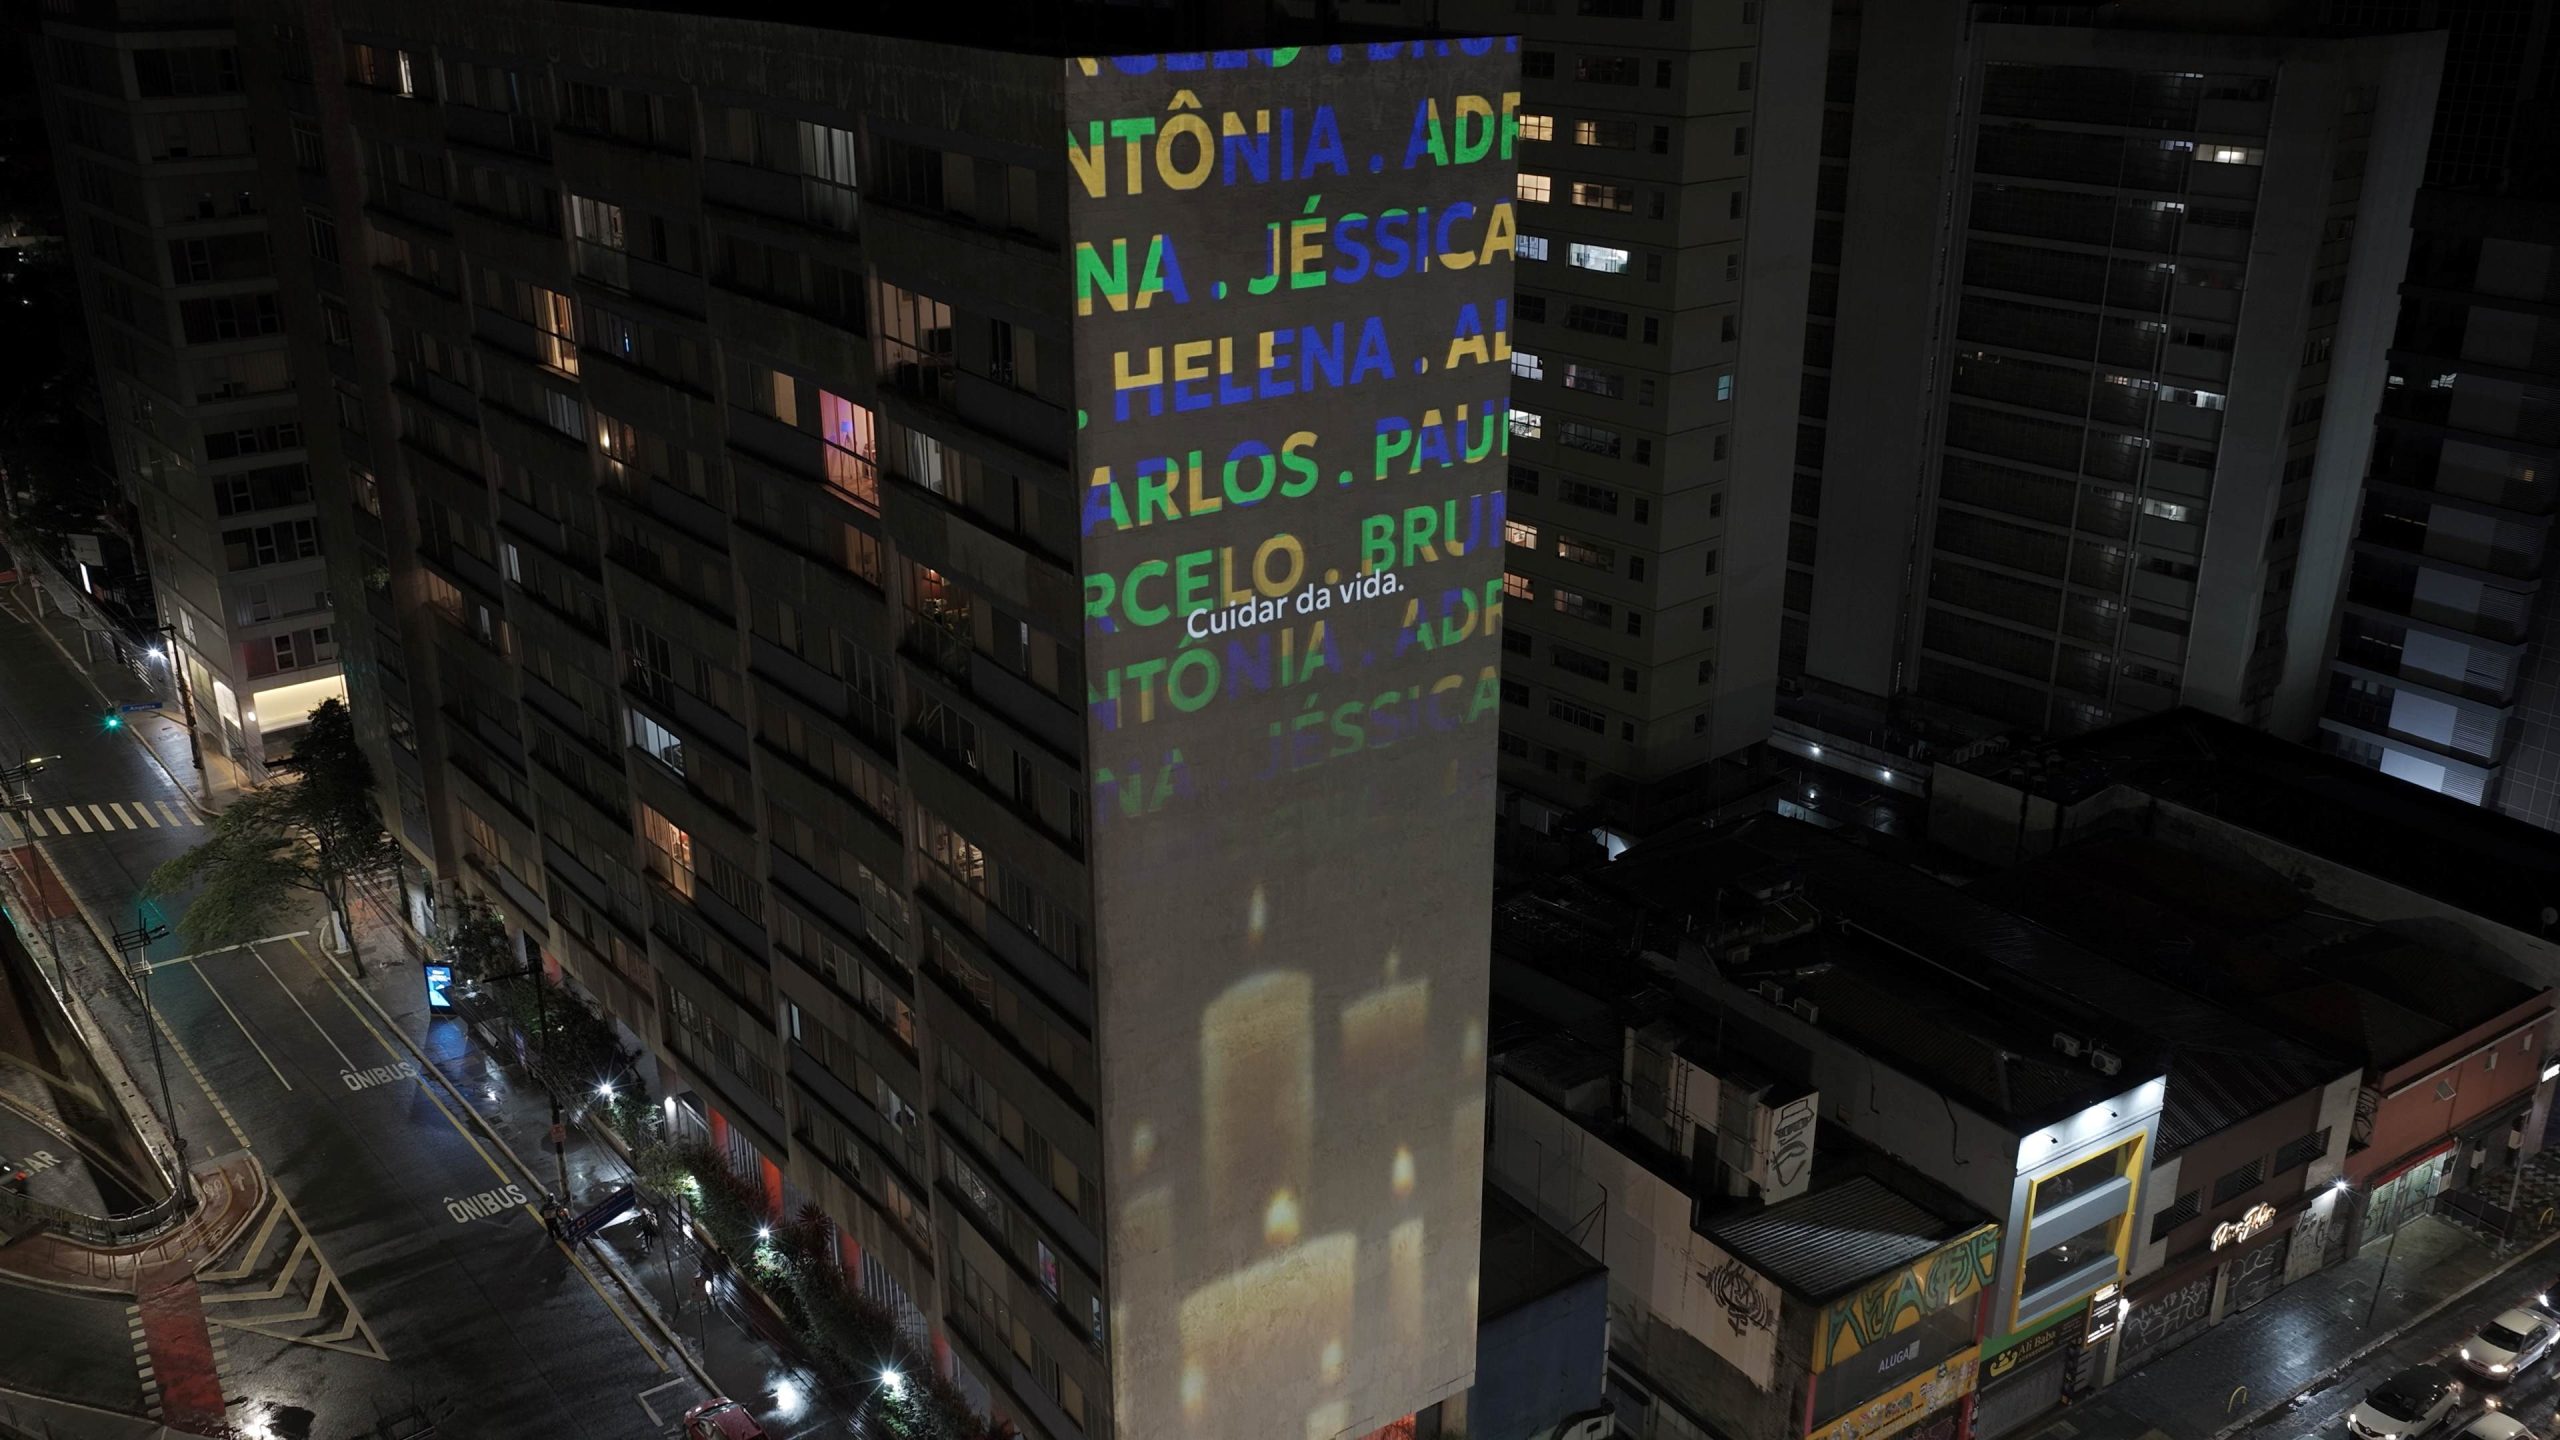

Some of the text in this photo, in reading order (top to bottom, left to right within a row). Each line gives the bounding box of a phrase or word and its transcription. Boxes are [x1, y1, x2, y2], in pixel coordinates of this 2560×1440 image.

[1076, 234, 1190, 317] NA
[1247, 194, 1516, 295] JÉSSICA
[1114, 316, 1396, 422] HELENA
[1081, 430, 1319, 538] ARLOS
[1084, 532, 1305, 634] RCELO
[1187, 567, 1404, 639] Cuidar da vida.
[340, 1061, 416, 1091] ÔNIBUS
[443, 1184, 527, 1224] ÔNIBUS
